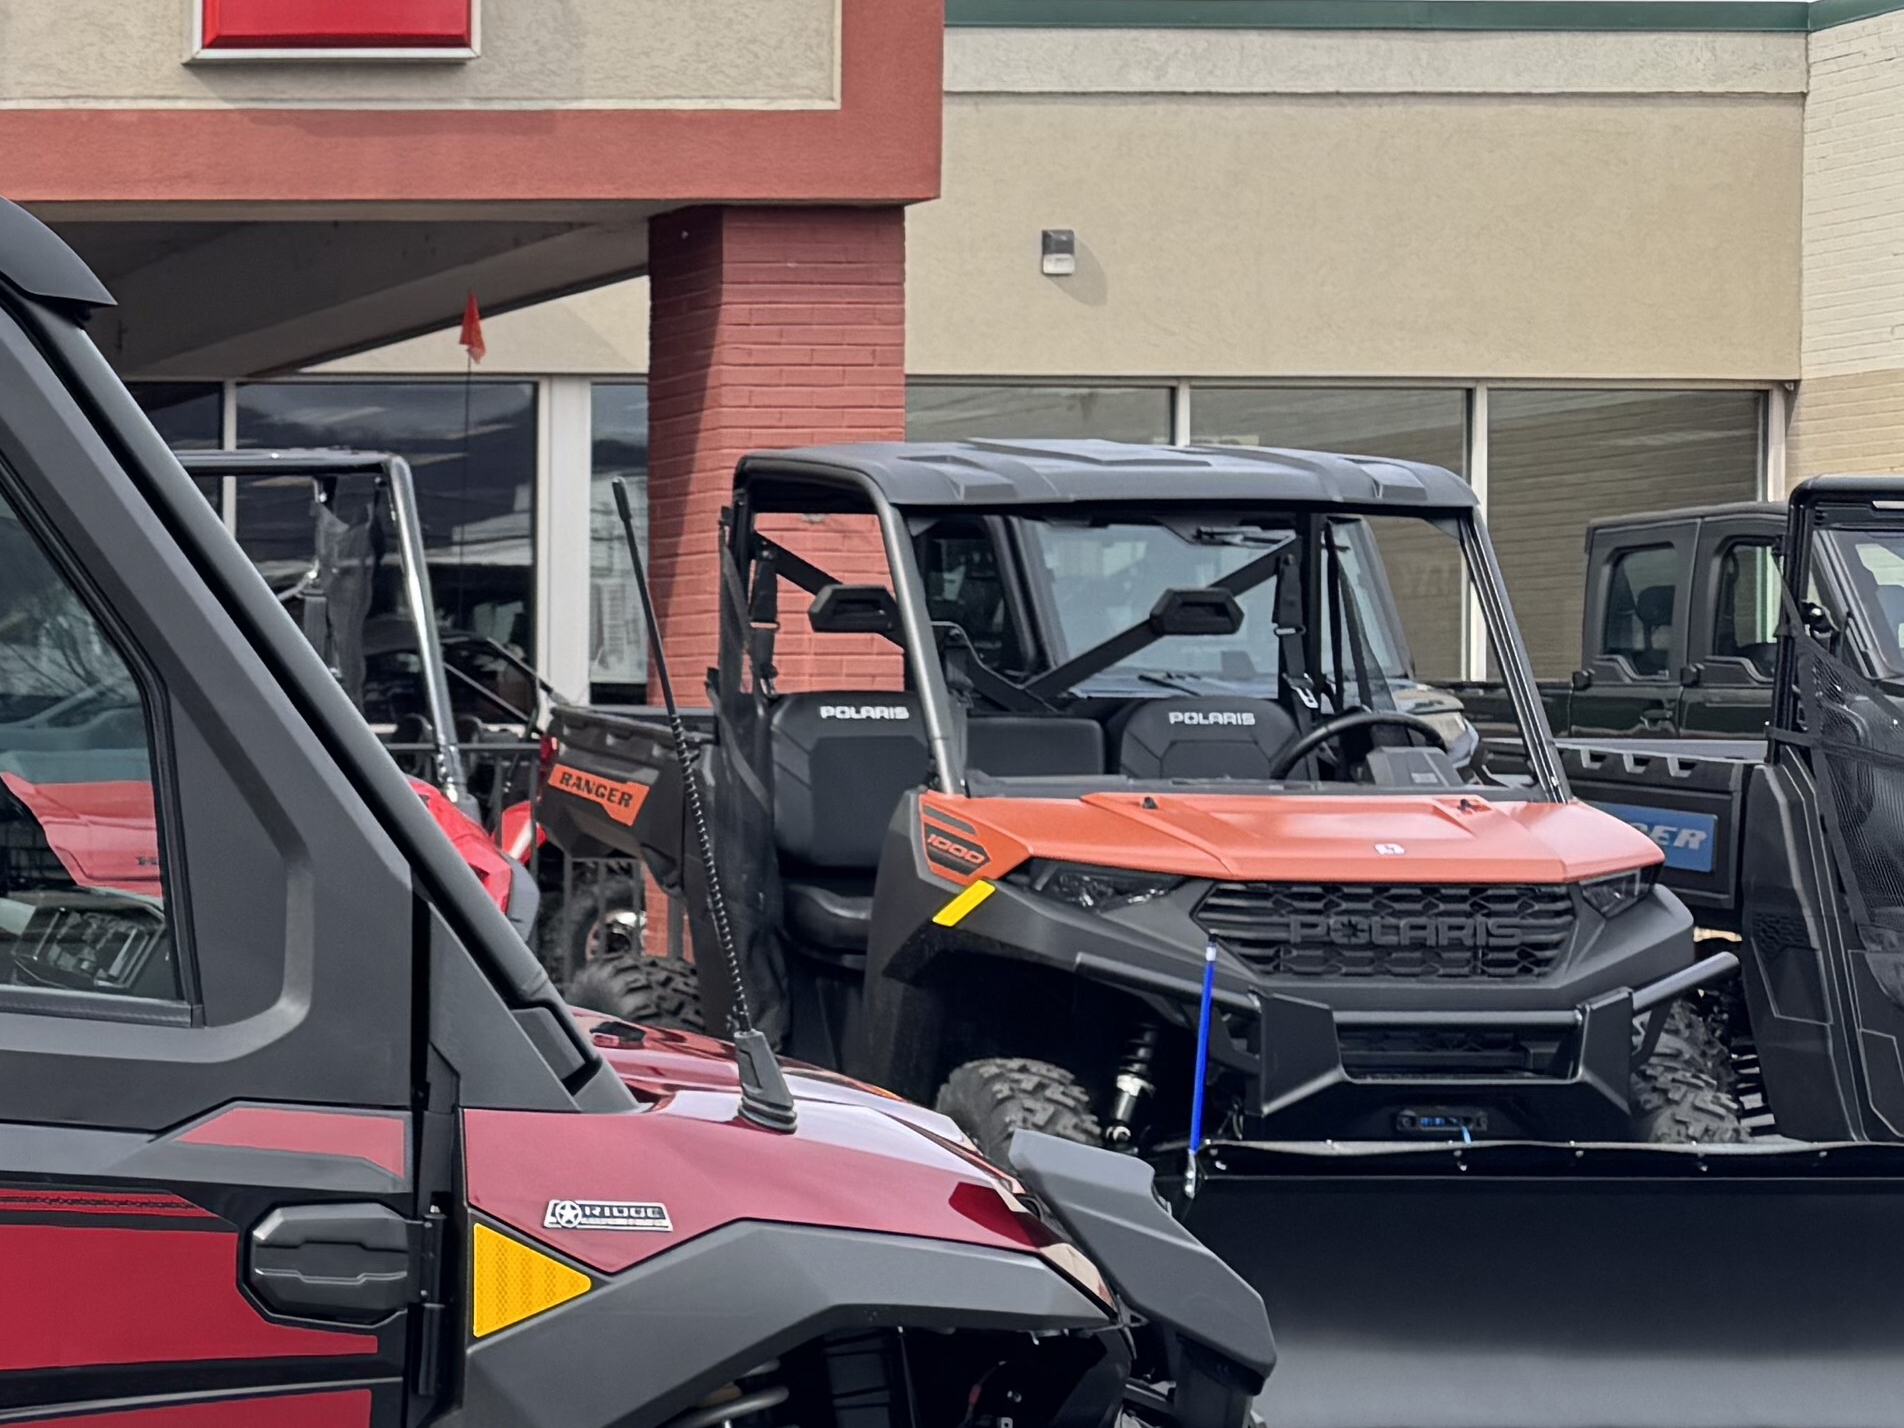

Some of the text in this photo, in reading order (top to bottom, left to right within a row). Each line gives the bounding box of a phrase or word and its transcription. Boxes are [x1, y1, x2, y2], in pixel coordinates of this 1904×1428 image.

[819, 705, 910, 720] POLARIS
[1168, 711, 1256, 726] POLARIS
[559, 771, 634, 808] RANGER
[927, 833, 985, 864] 1000
[1290, 916, 1525, 946] POLARIS
